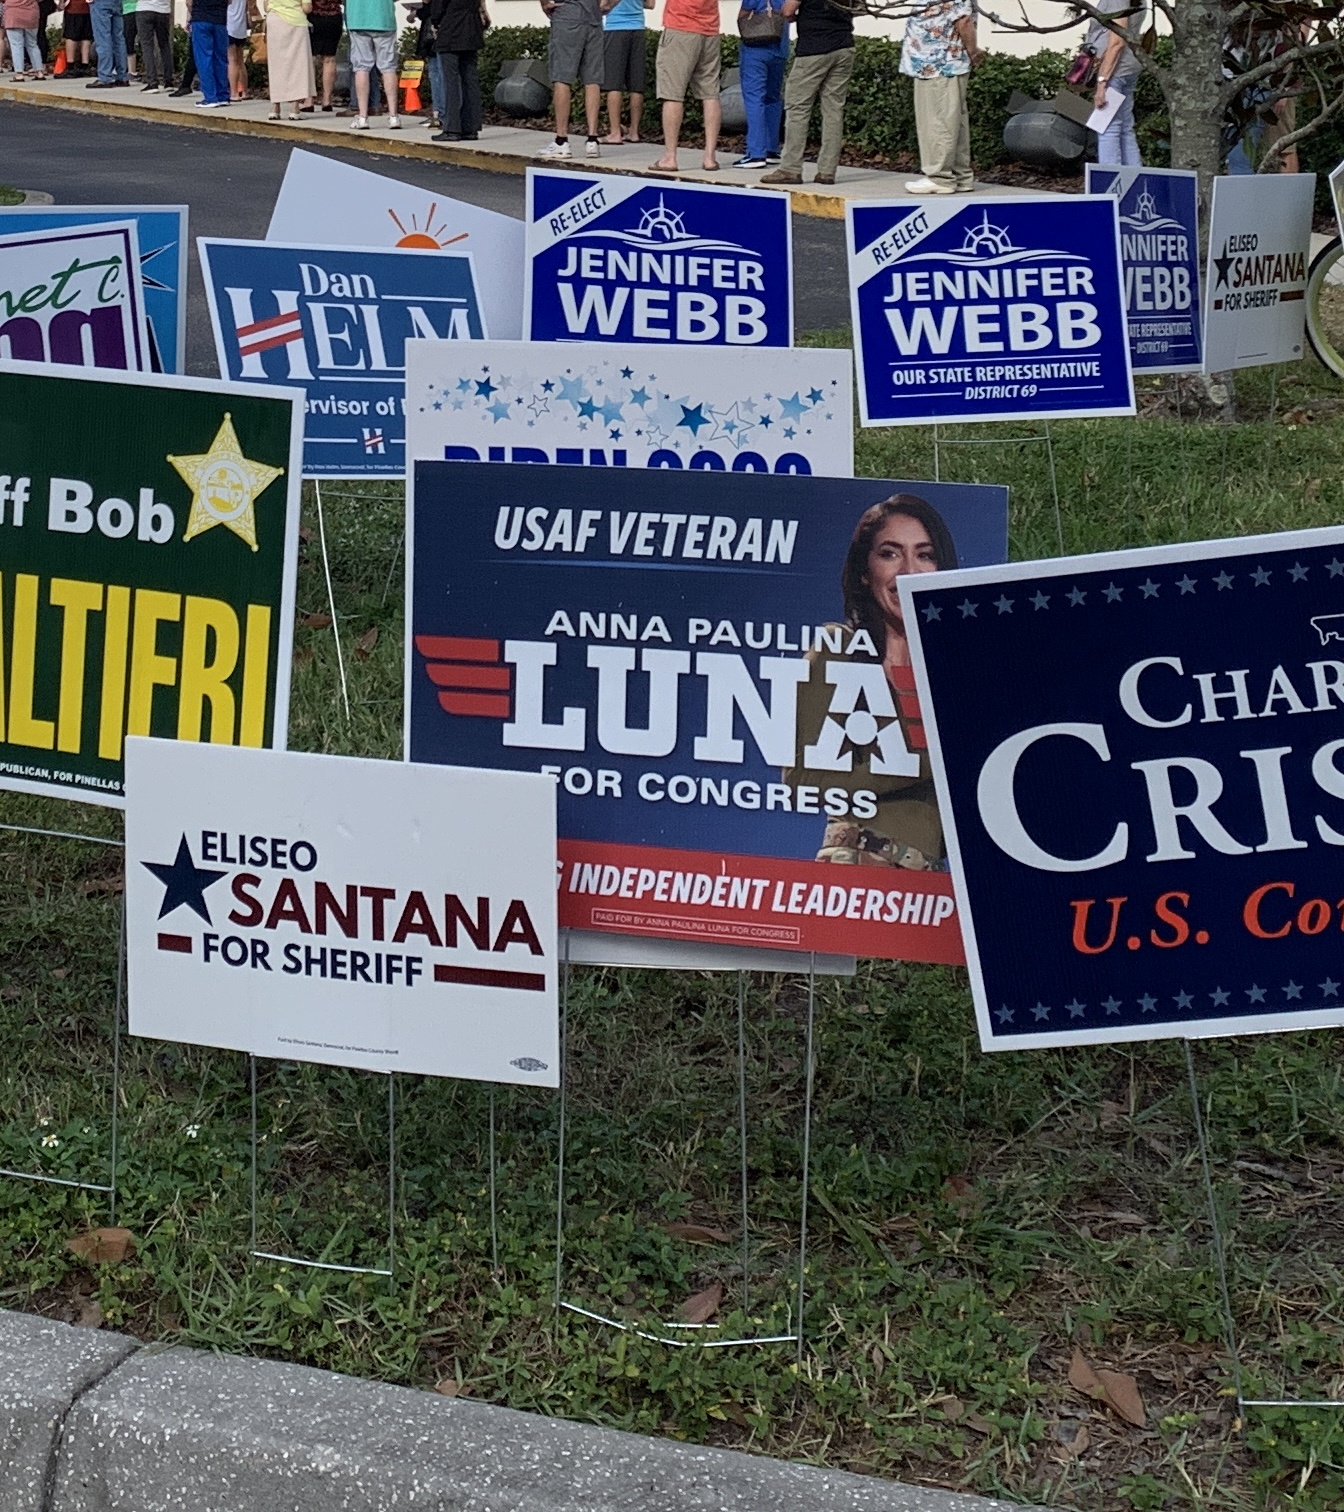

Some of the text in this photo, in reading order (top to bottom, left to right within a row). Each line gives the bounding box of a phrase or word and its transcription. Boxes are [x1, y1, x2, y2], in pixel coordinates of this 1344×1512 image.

[549, 188, 608, 237] RE-ELECT
[871, 212, 930, 266] RE-ELECT
[1121, 234, 1189, 262] NNIFER
[1228, 234, 1258, 254] ELISEO
[298, 263, 378, 300] Dan
[557, 246, 765, 291] JENNIFER
[883, 266, 1097, 304] JENNIFER
[1125, 267, 1192, 311] EBB
[1233, 252, 1306, 288] SANTANA
[557, 282, 769, 345] WEBB
[1224, 289, 1278, 312] FOR SHERIFF
[884, 301, 1102, 357] WEBB
[892, 361, 1101, 387] OUR STATE REPRESENTATIVE
[964, 384, 1038, 400] DISTRICT 69
[304, 395, 396, 416] rvisor of
[47, 477, 175, 544] Bob
[493, 505, 799, 565] USAF VETERAN
[544, 609, 879, 658] ANNA PAULINA
[502, 638, 921, 778] LUNA
[53, 770, 73, 782] FOR
[74, 774, 120, 791] PINELLAS
[540, 764, 879, 821] FOR CONGRESS
[201, 830, 318, 872] ELISEO
[227, 872, 545, 957] SANTANA
[568, 862, 770, 911] INDEPENDENT
[771, 880, 955, 928] LEADERSHIP
[595, 912, 796, 939] PAID FOR BY ANNA PAULINA LUNA FOR CONGRESS
[1069, 890, 1210, 956] U.S.
[202, 932, 424, 988] FOR SHERIFF
